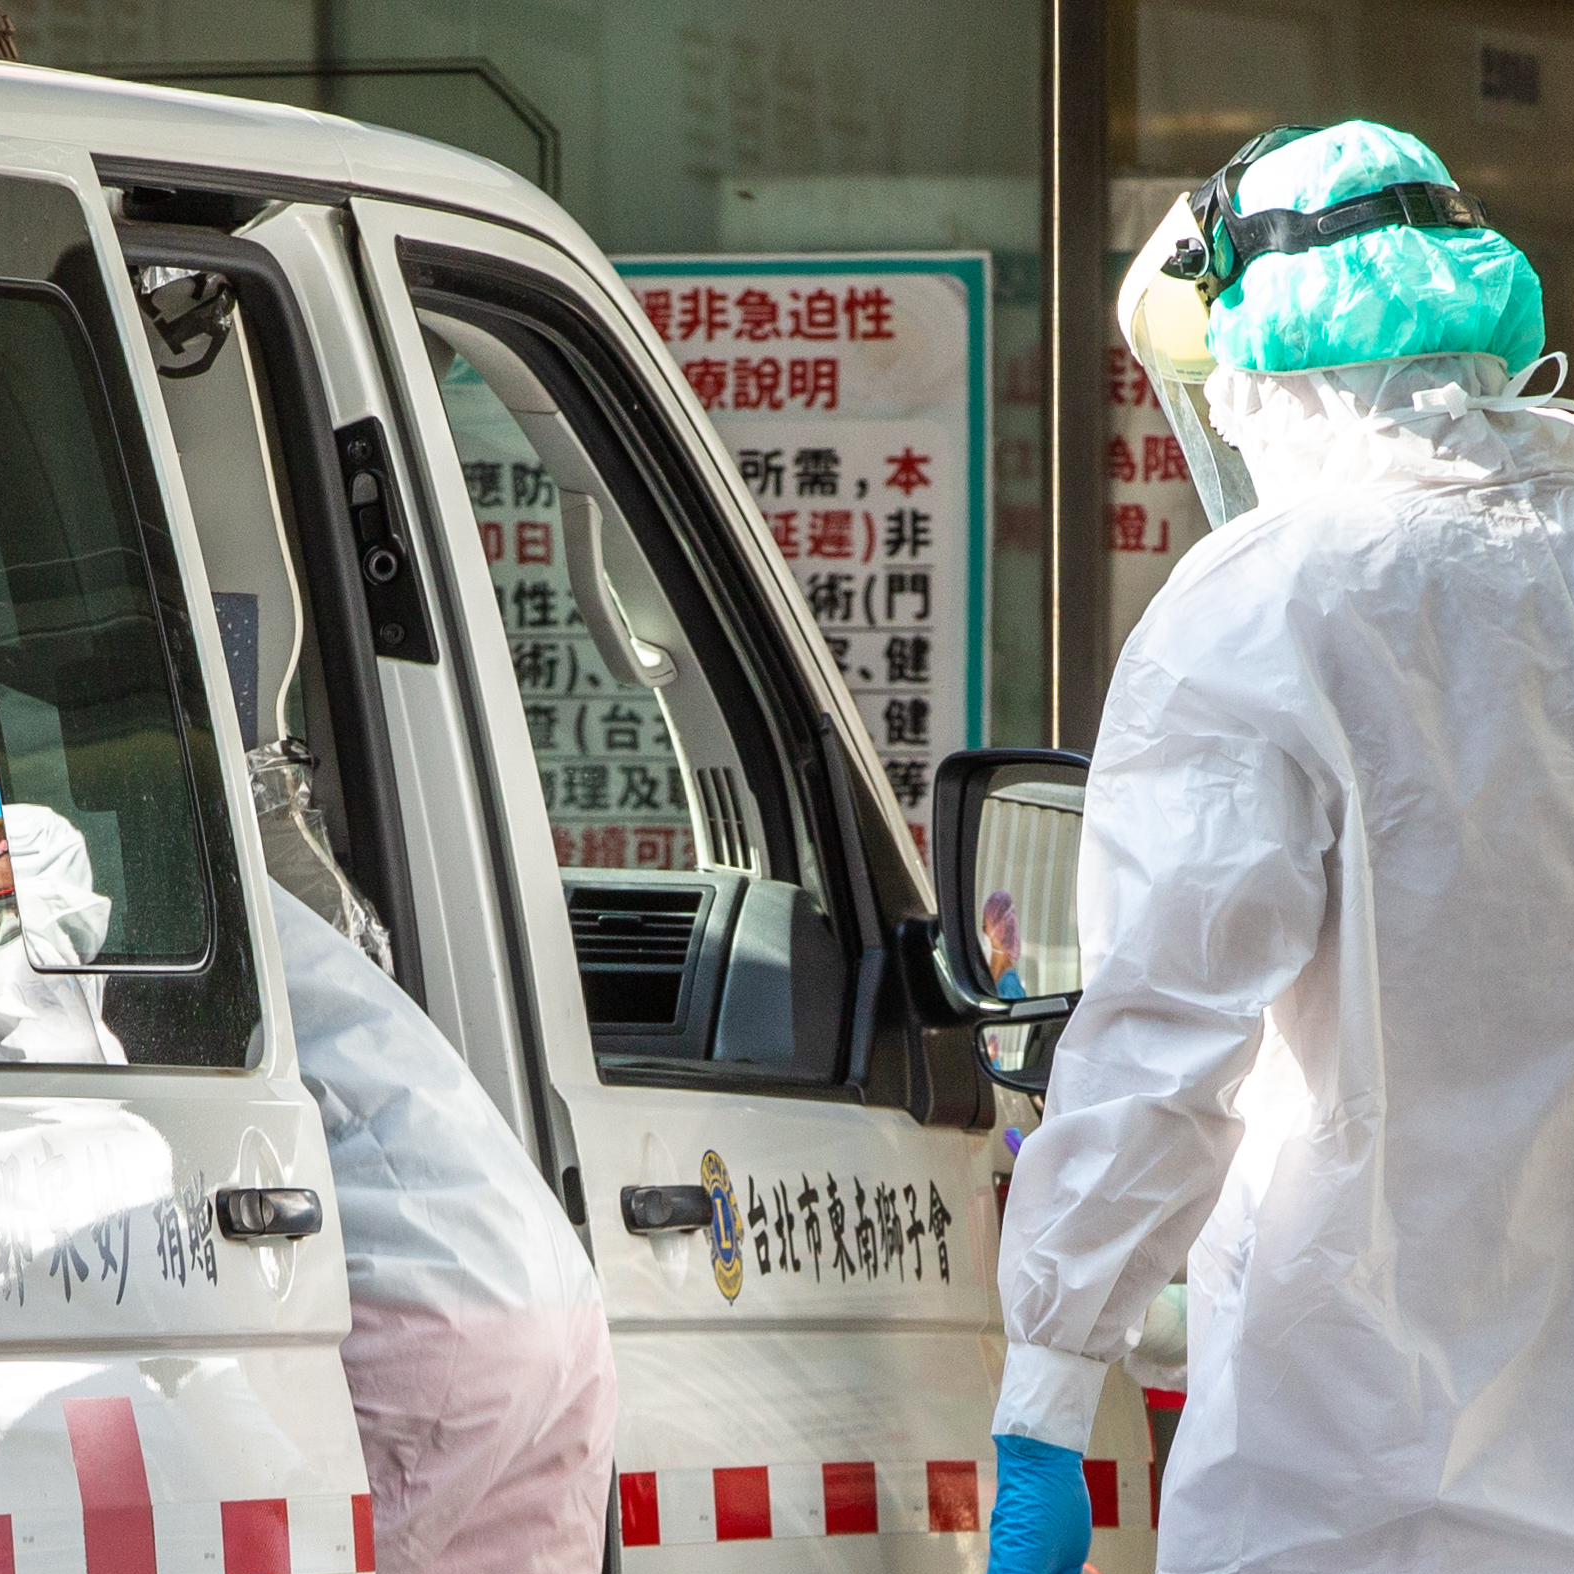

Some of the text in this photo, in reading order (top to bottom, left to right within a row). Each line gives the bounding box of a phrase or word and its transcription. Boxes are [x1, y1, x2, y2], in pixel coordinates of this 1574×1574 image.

[747, 1171, 952, 1285] 台北市東南獅子會
